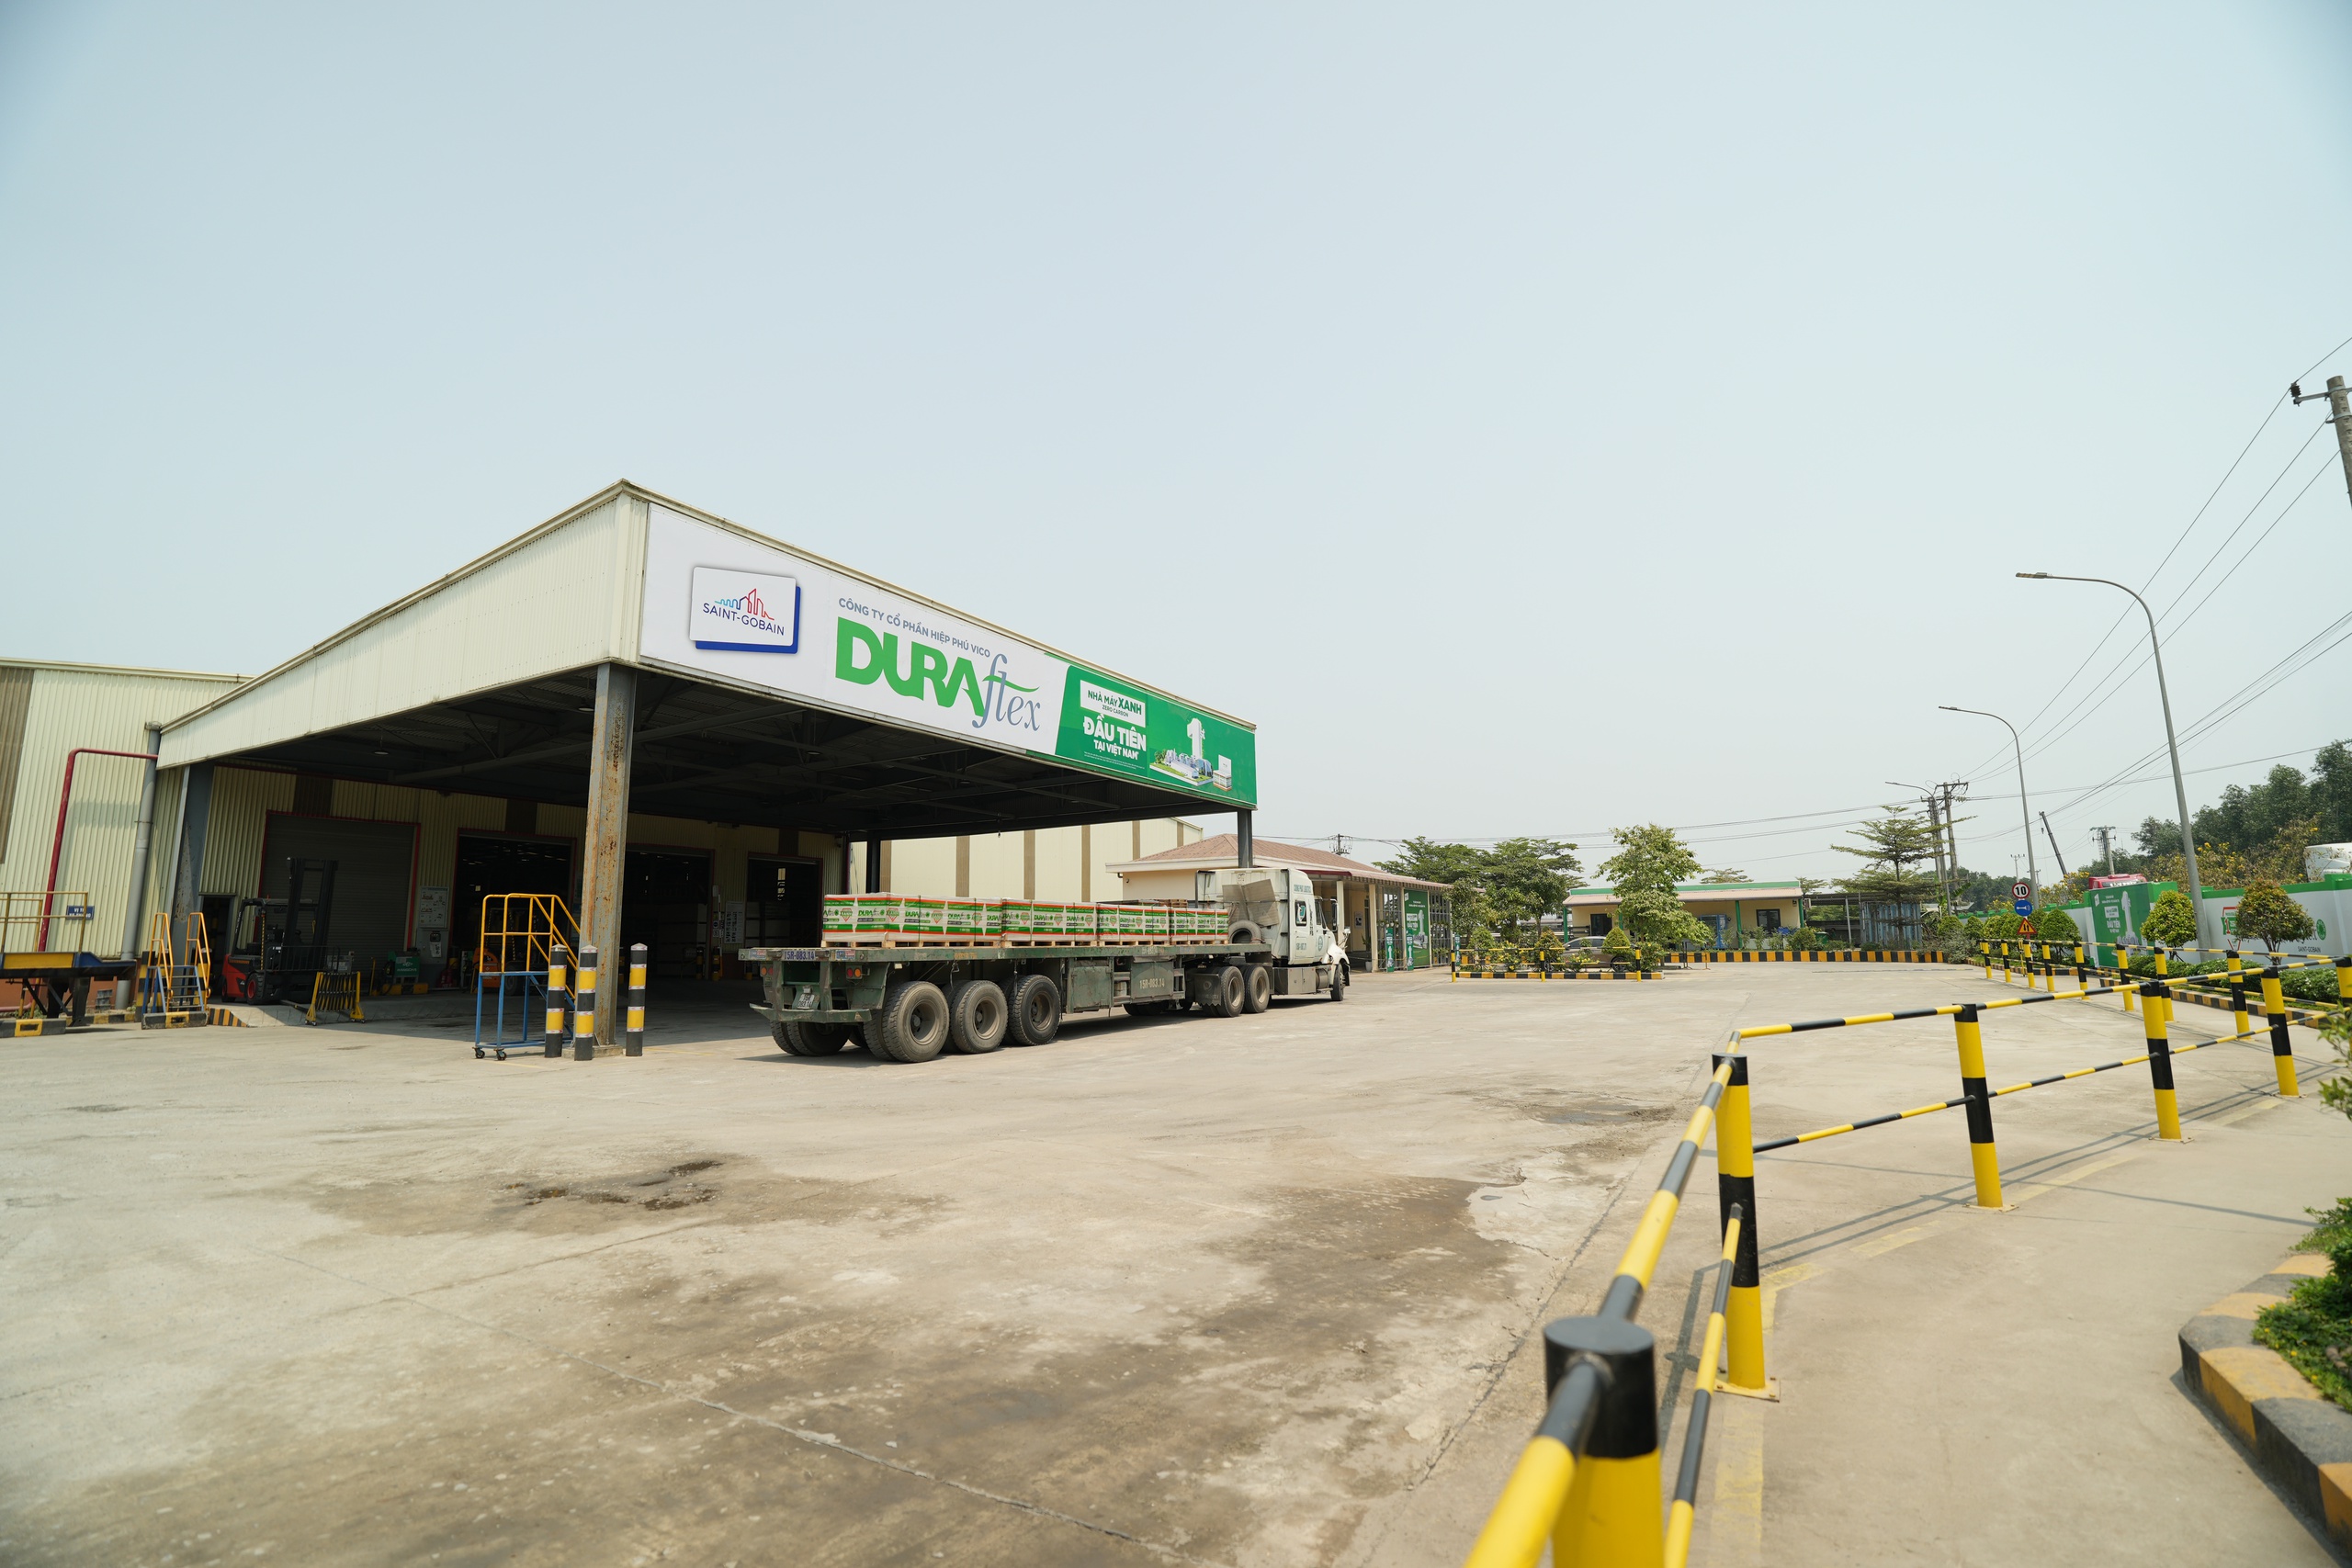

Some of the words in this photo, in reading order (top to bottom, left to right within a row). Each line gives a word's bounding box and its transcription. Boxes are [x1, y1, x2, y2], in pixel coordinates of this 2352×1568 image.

[703, 603, 785, 636] SAINT-GOBAIN
[838, 598, 869, 616] CÔNG
[872, 608, 884, 620] TY
[887, 614, 901, 626] CỔ
[903, 621, 929, 637] PHẦN
[931, 630, 950, 644] HIỆP
[952, 637, 969, 651] PHÚ
[971, 645, 990, 658] VICO
[1088, 690, 1102, 703] NHÀ
[1104, 695, 1118, 706] MÁY
[1118, 697, 1142, 715] XANH
[1102, 705, 1113, 713] ZERO
[1114, 707, 1129, 717] CARBON
[1083, 713, 1114, 741] ĐẦU
[1117, 727, 1147, 751] TIÊN
[1093, 739, 1105, 752] TẠI
[1106, 743, 1122, 756] VIỆT
[2015, 886, 2027, 896] 10
[785, 951, 815, 961] 15R-083.14
[1140, 978, 1165, 989] 15R-083.14
